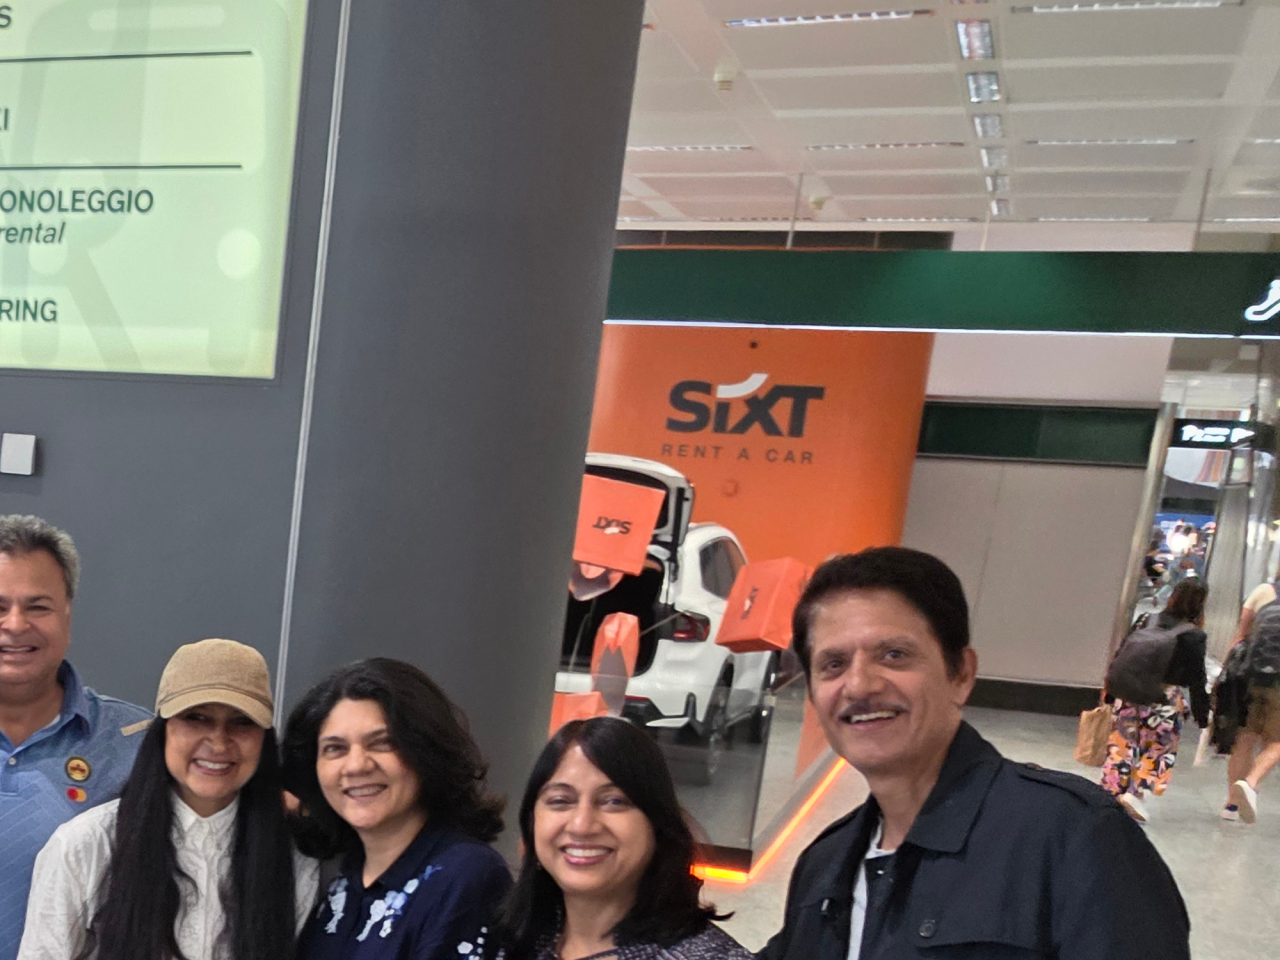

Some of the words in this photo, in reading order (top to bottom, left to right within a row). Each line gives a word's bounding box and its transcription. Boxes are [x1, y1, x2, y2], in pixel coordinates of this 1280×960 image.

[660, 443, 723, 459] RENT
[737, 447, 750, 461] A
[765, 449, 814, 465] CAR
